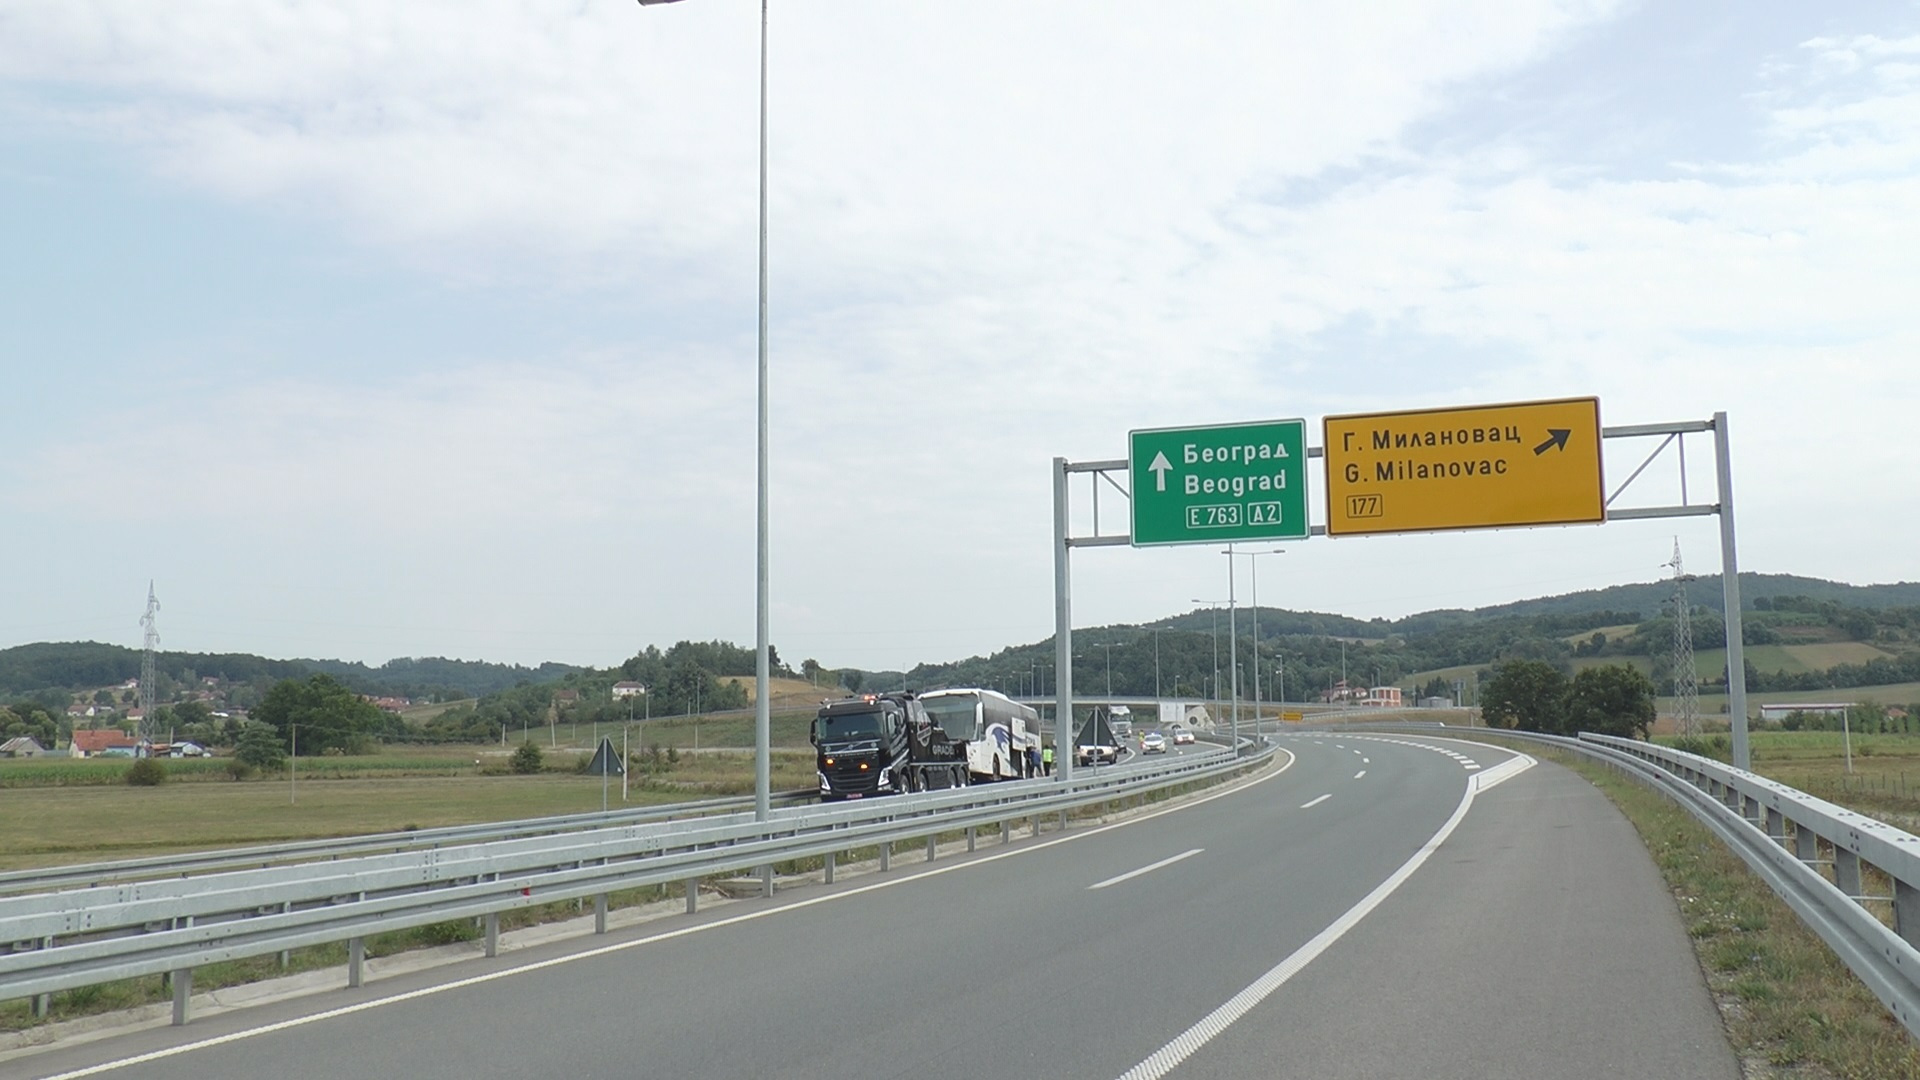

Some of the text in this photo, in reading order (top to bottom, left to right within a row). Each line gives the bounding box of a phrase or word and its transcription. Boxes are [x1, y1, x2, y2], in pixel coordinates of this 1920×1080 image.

[1343, 426, 1521, 451] Г. Милановац
[1184, 444, 1289, 465] Београд
[1345, 459, 1507, 483] G. Milanovac
[1185, 469, 1286, 497] Beograd
[1191, 506, 1238, 525] E 763
[1351, 497, 1377, 515] 177
